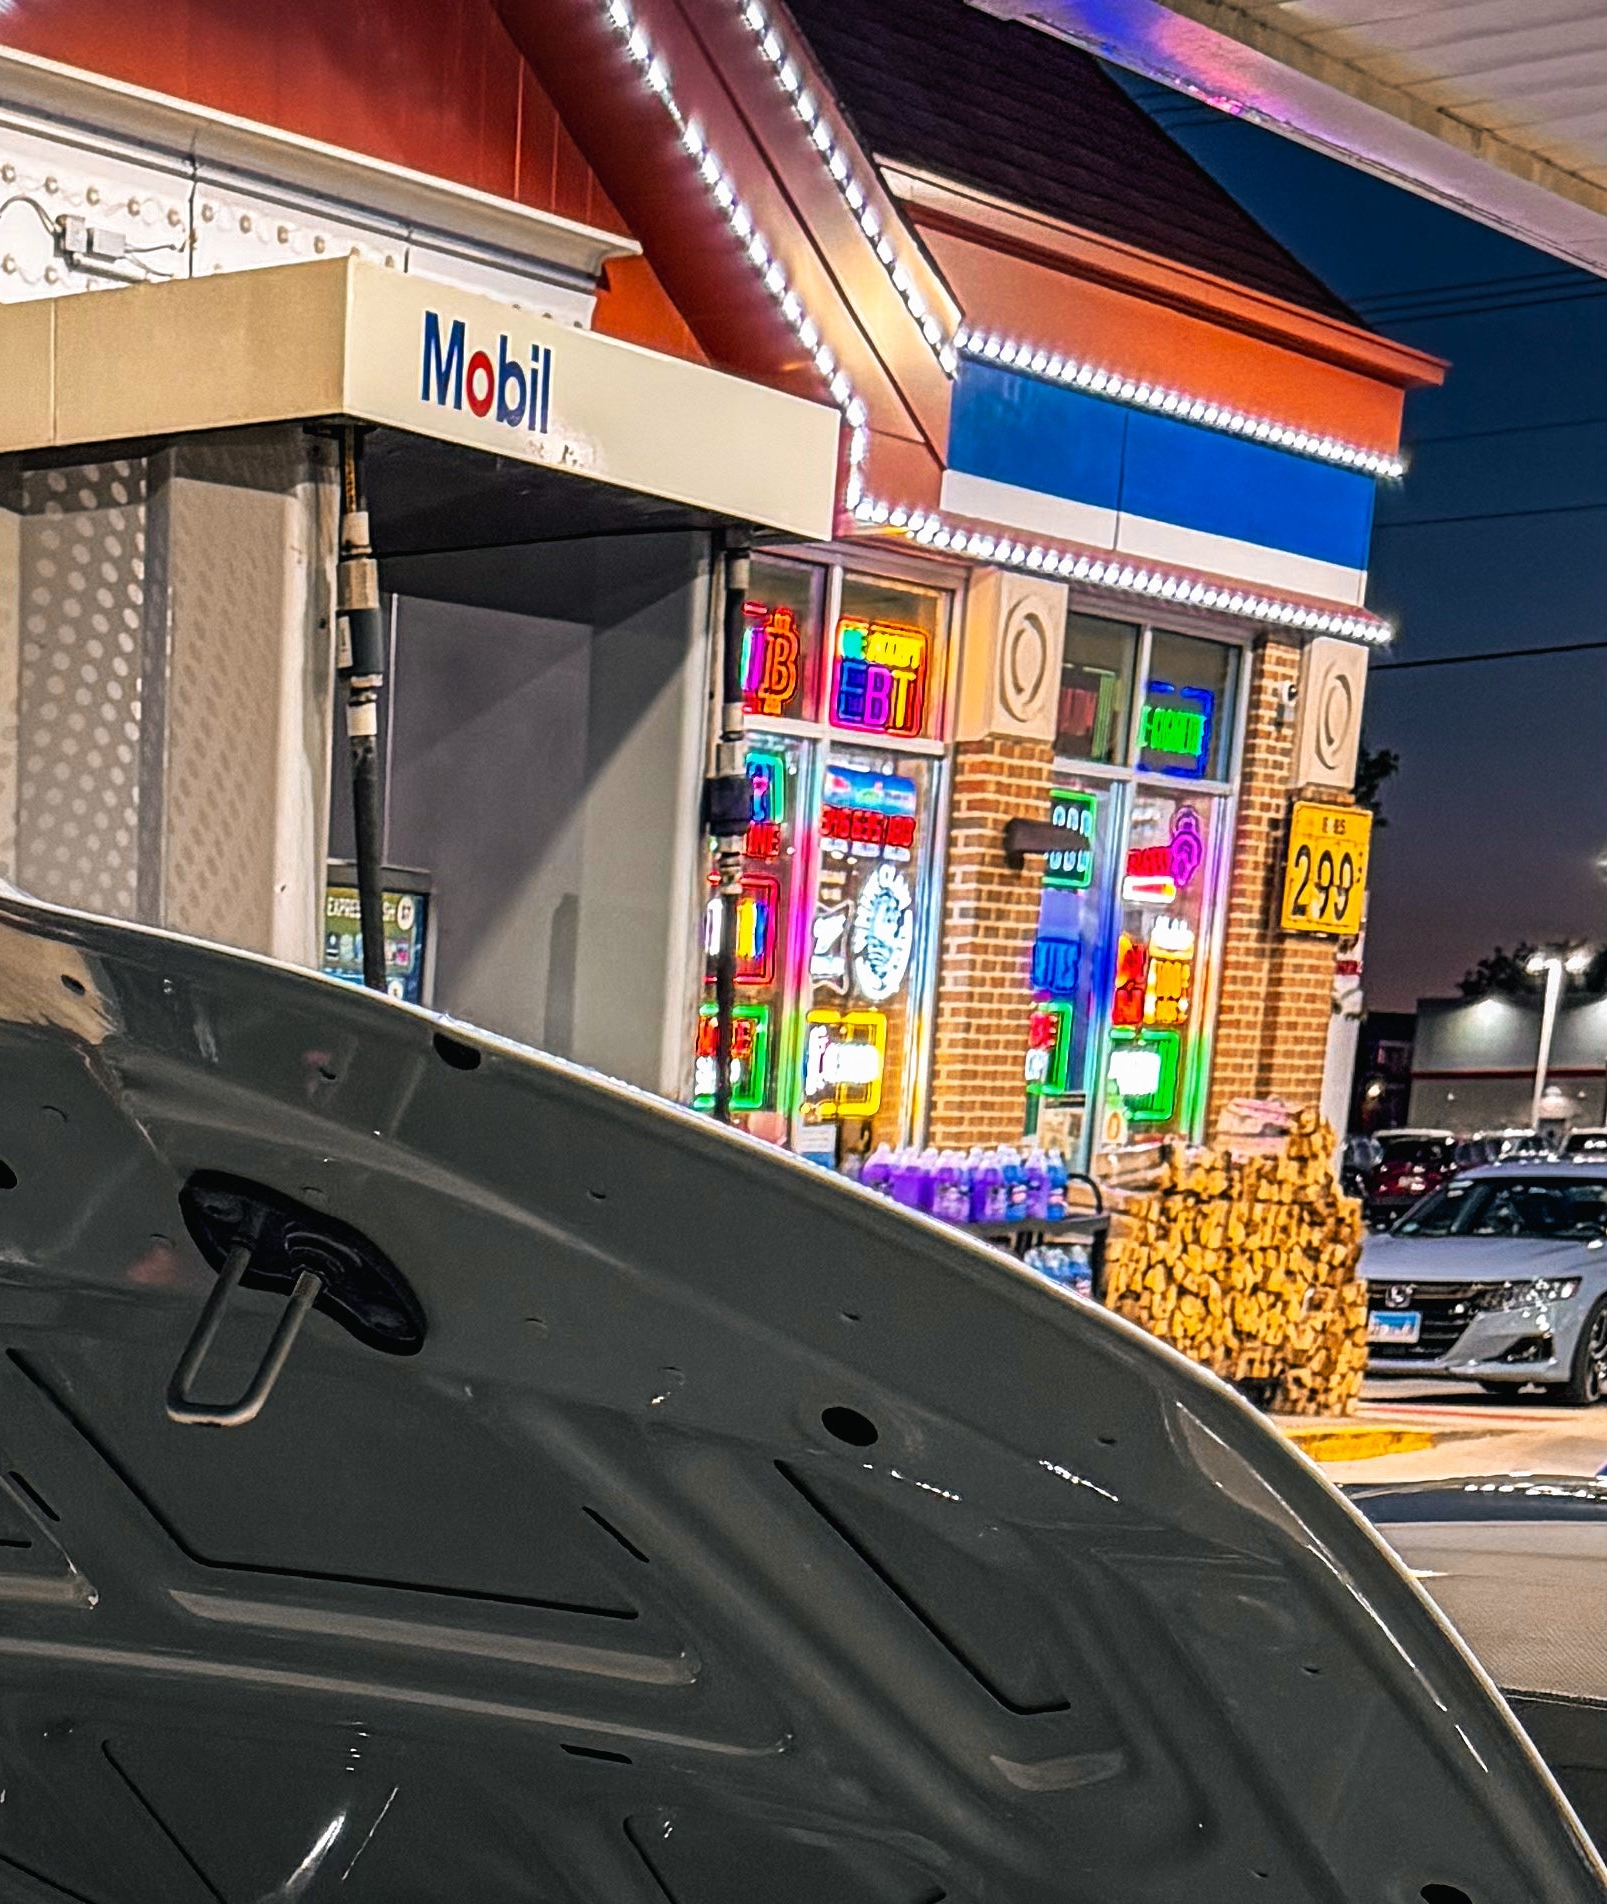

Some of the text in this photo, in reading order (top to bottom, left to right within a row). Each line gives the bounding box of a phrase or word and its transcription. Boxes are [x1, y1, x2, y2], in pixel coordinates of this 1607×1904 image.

[420, 310, 552, 434] Mobil
[838, 661, 917, 728] EBT
[1291, 843, 1355, 921] 299
